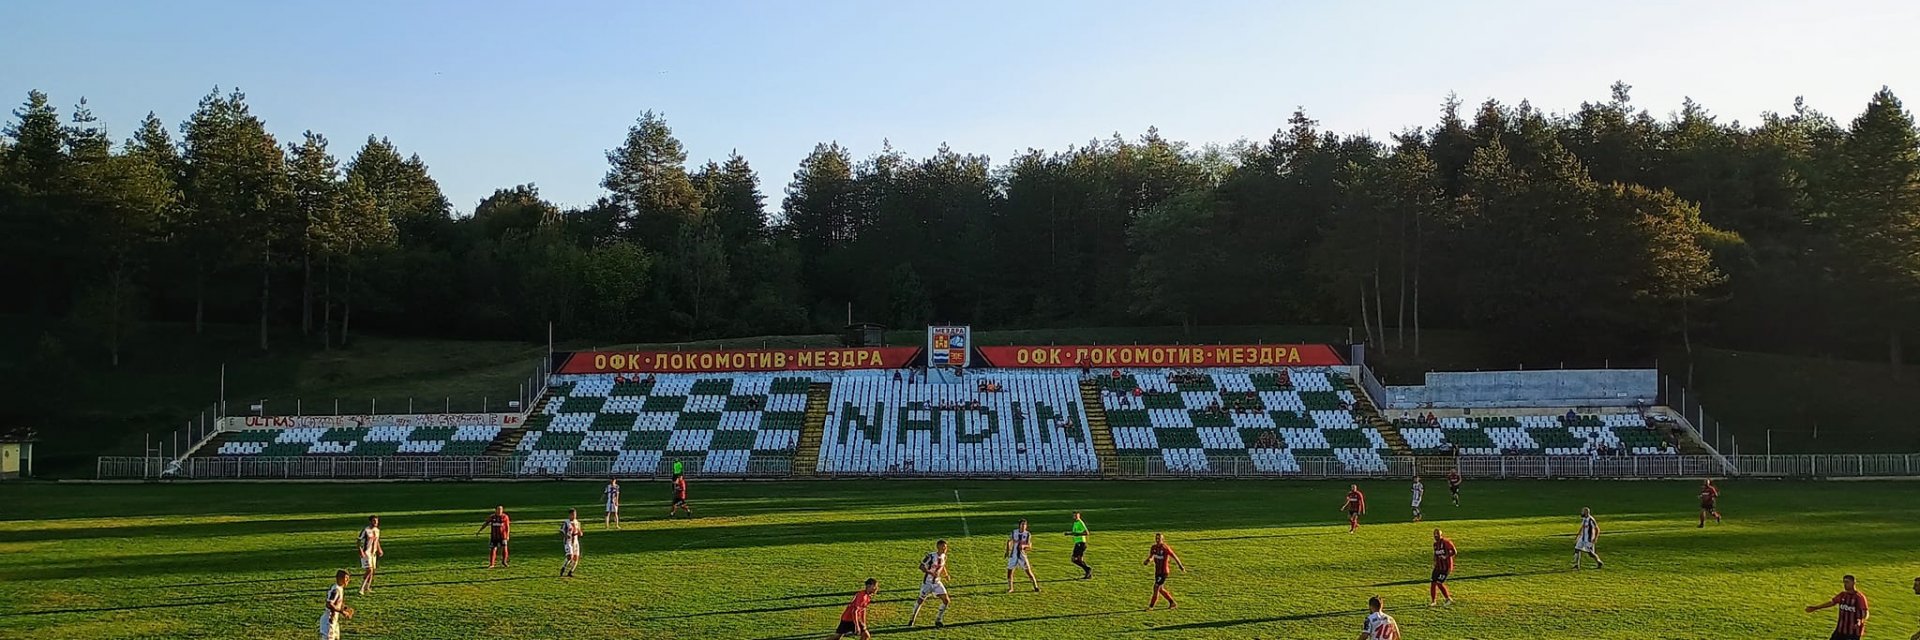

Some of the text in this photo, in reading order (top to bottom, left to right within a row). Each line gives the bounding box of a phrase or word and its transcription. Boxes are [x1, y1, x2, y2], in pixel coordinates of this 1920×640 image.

[595, 350, 883, 370] ОФК ЛОКОМОТИВ МЕЗДРА
[1017, 347, 1301, 365] ОФК ЛОКОМОТИВ МЕЗДРА
[245, 416, 296, 428] ULTRAS
[1374, 623, 1396, 640] 10
